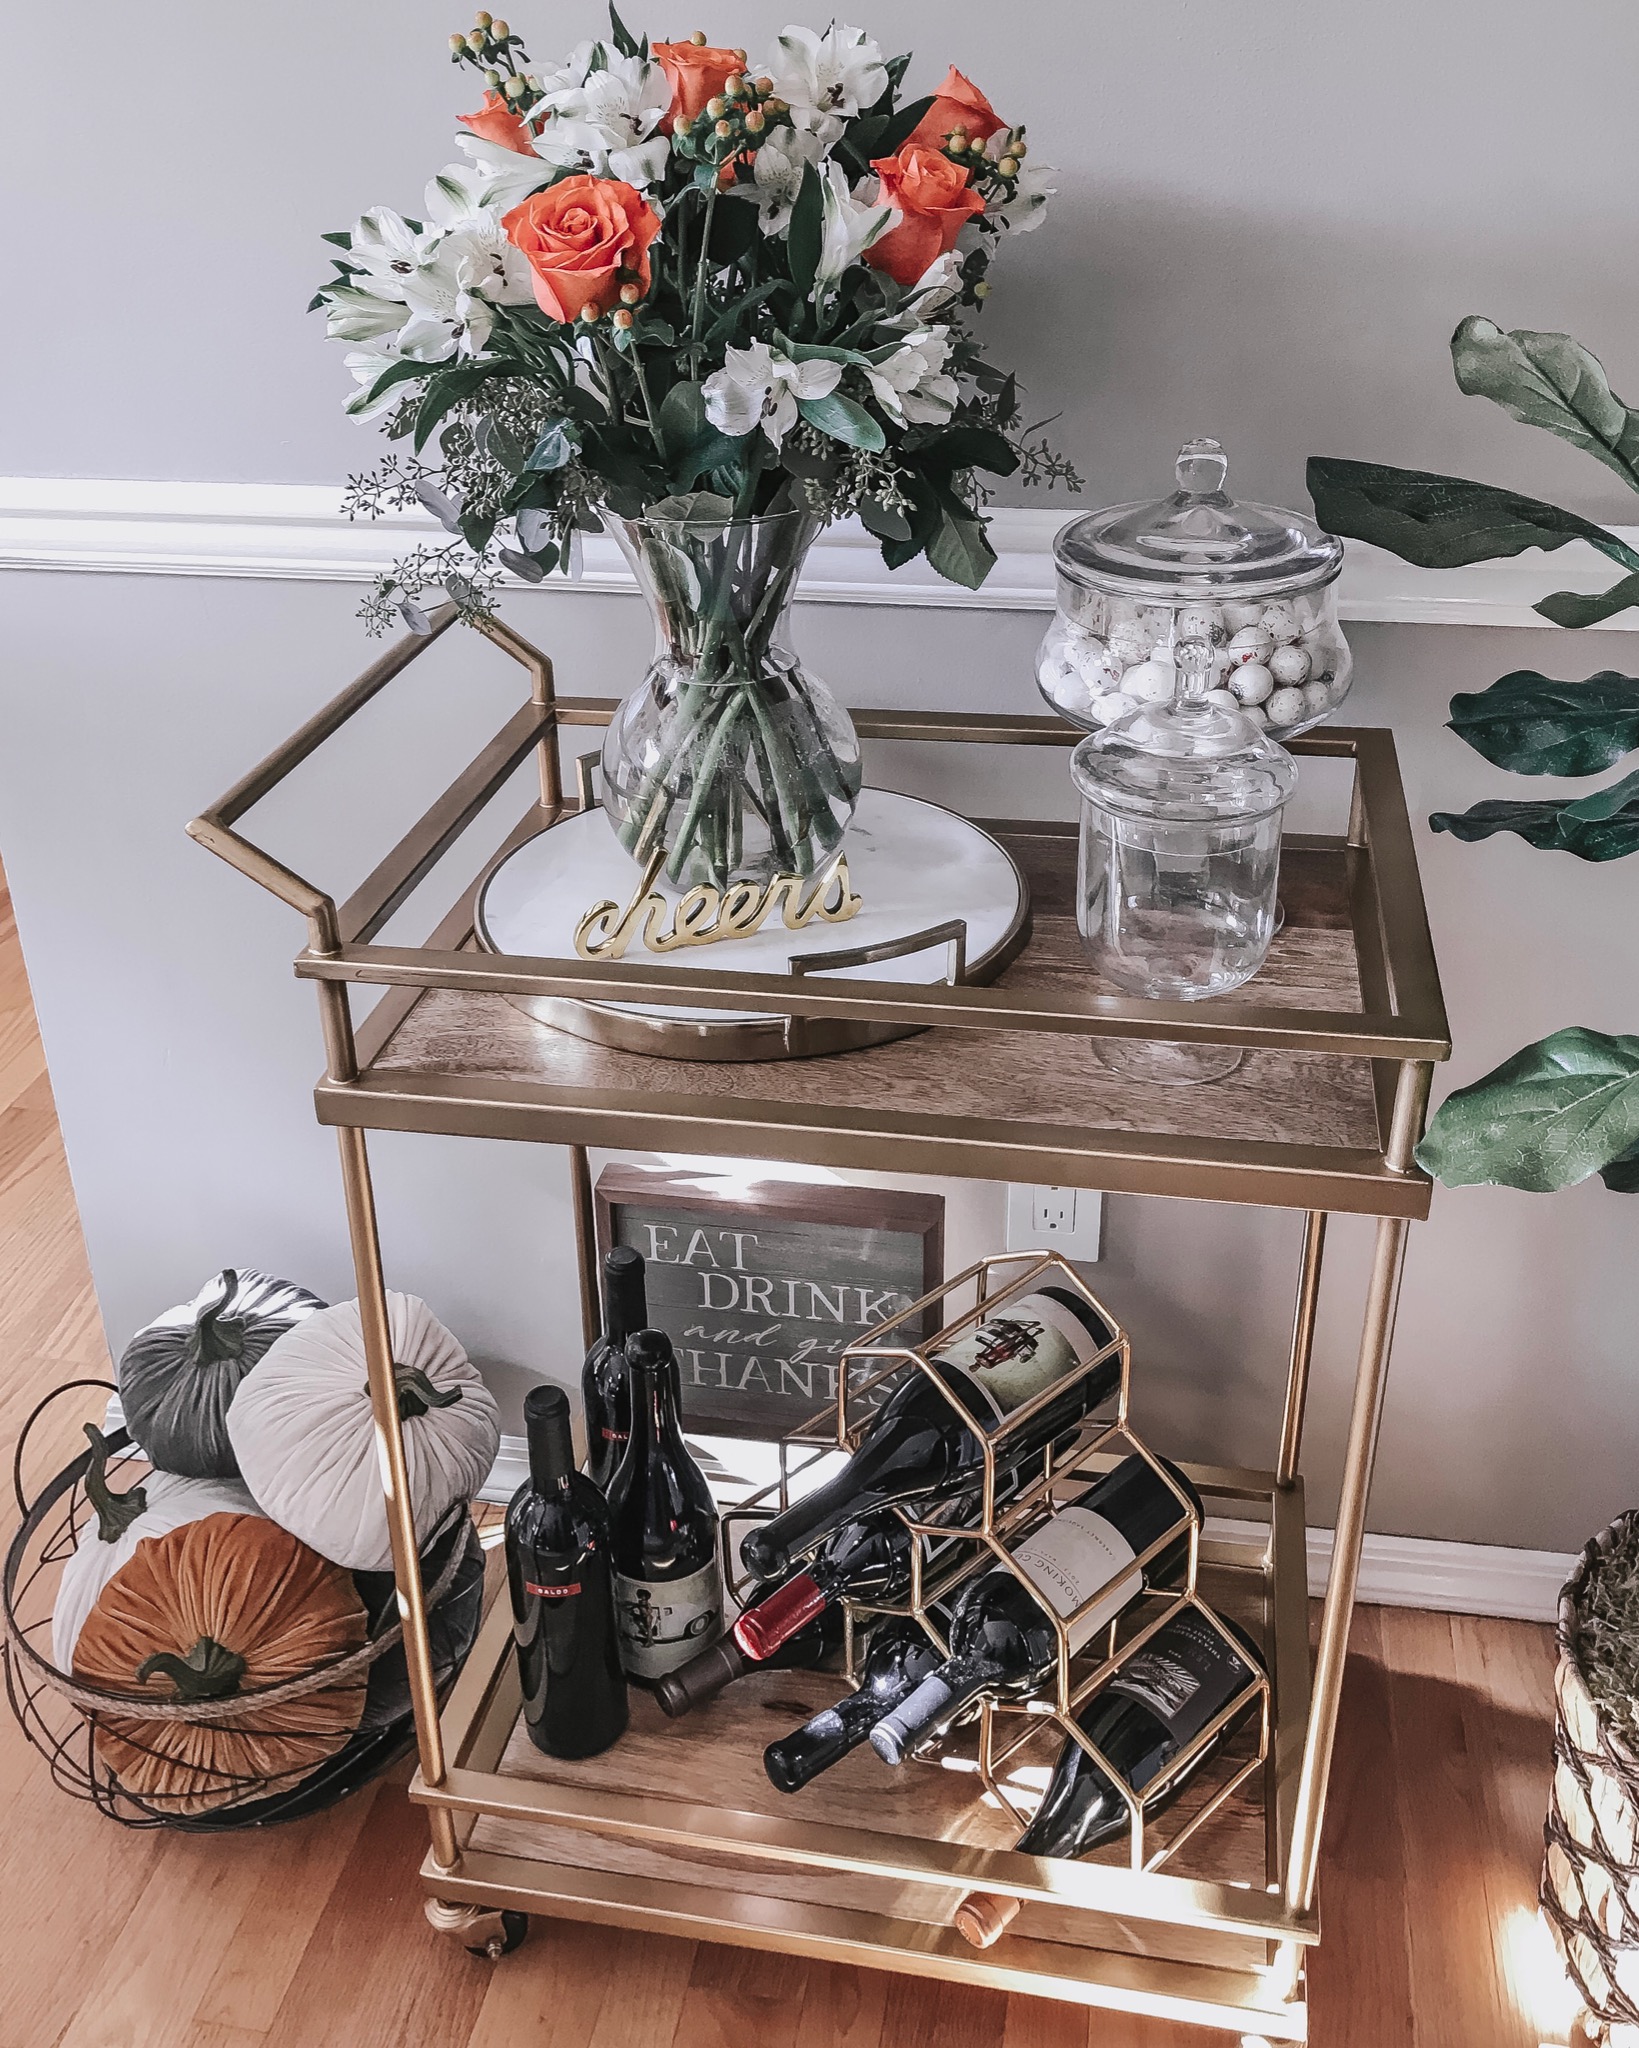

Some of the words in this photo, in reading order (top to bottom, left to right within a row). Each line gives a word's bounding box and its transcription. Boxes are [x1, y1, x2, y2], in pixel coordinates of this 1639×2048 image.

[574, 845, 864, 960] cheers
[643, 1224, 759, 1270] EAT
[698, 1272, 899, 1328] DRINK
[684, 1323, 782, 1347] and
[789, 1338, 849, 1364] gi
[1034, 1559, 1082, 1608] MOKING
